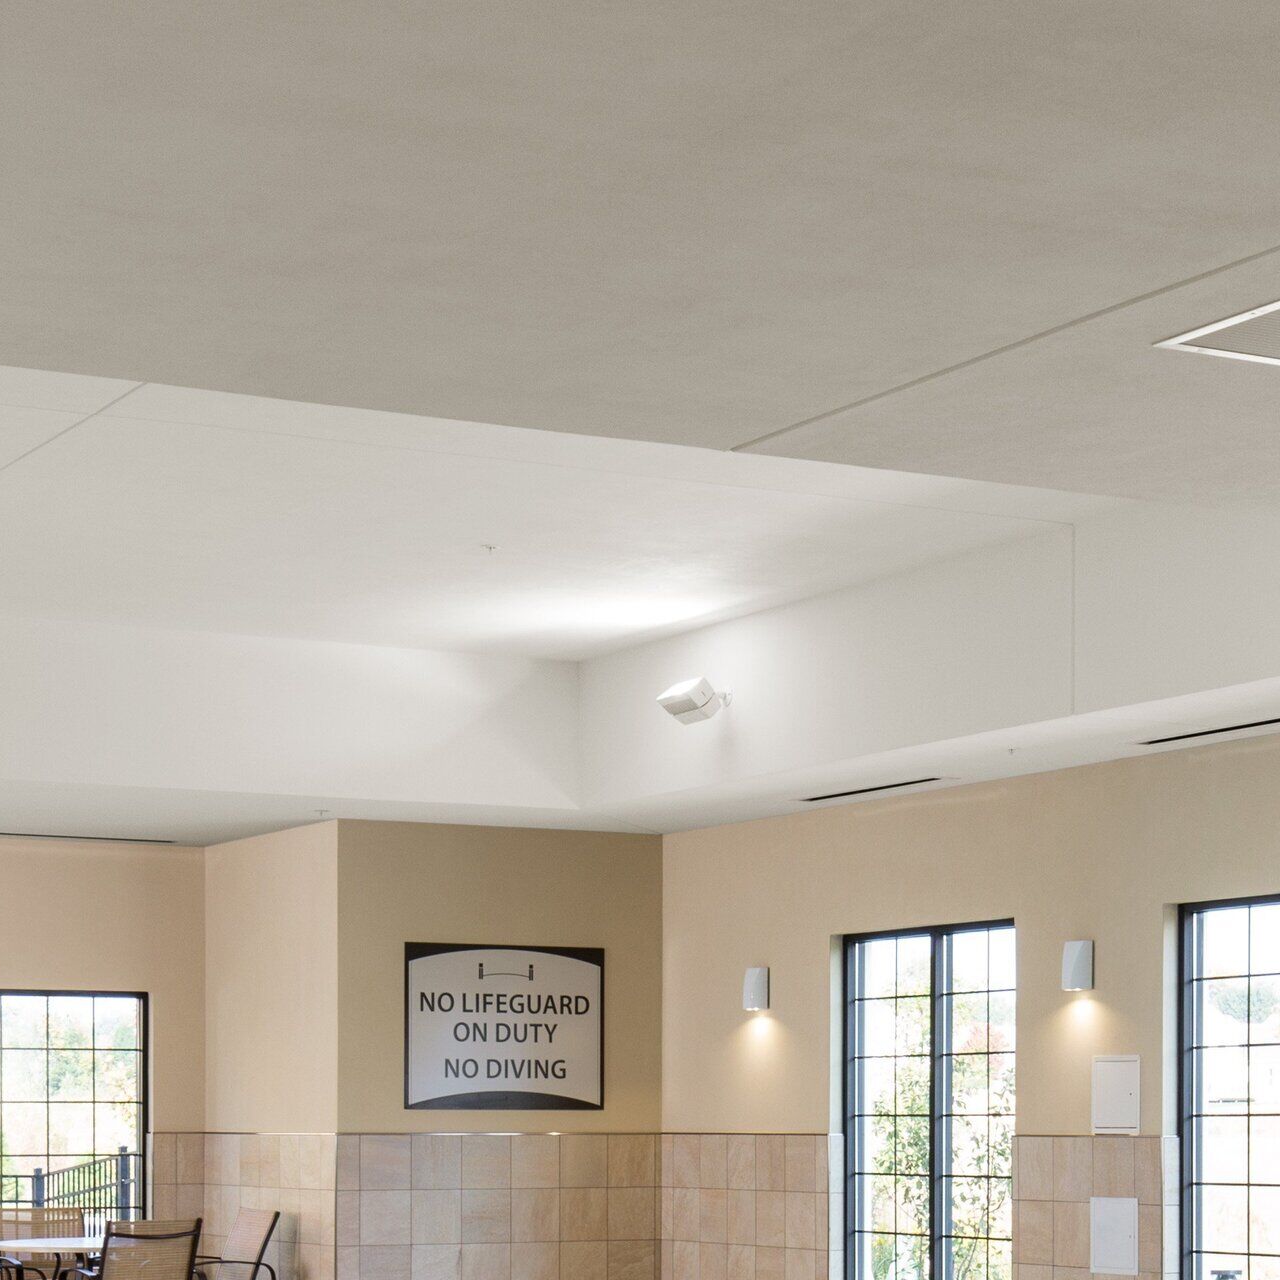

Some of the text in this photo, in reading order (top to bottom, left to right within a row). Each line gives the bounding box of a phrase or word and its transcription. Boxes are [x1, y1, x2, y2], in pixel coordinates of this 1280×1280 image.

[420, 992, 590, 1015] NO LIFEGUARD
[453, 1022, 558, 1043] ON DUTY
[444, 1058, 567, 1079] NO DIVING
